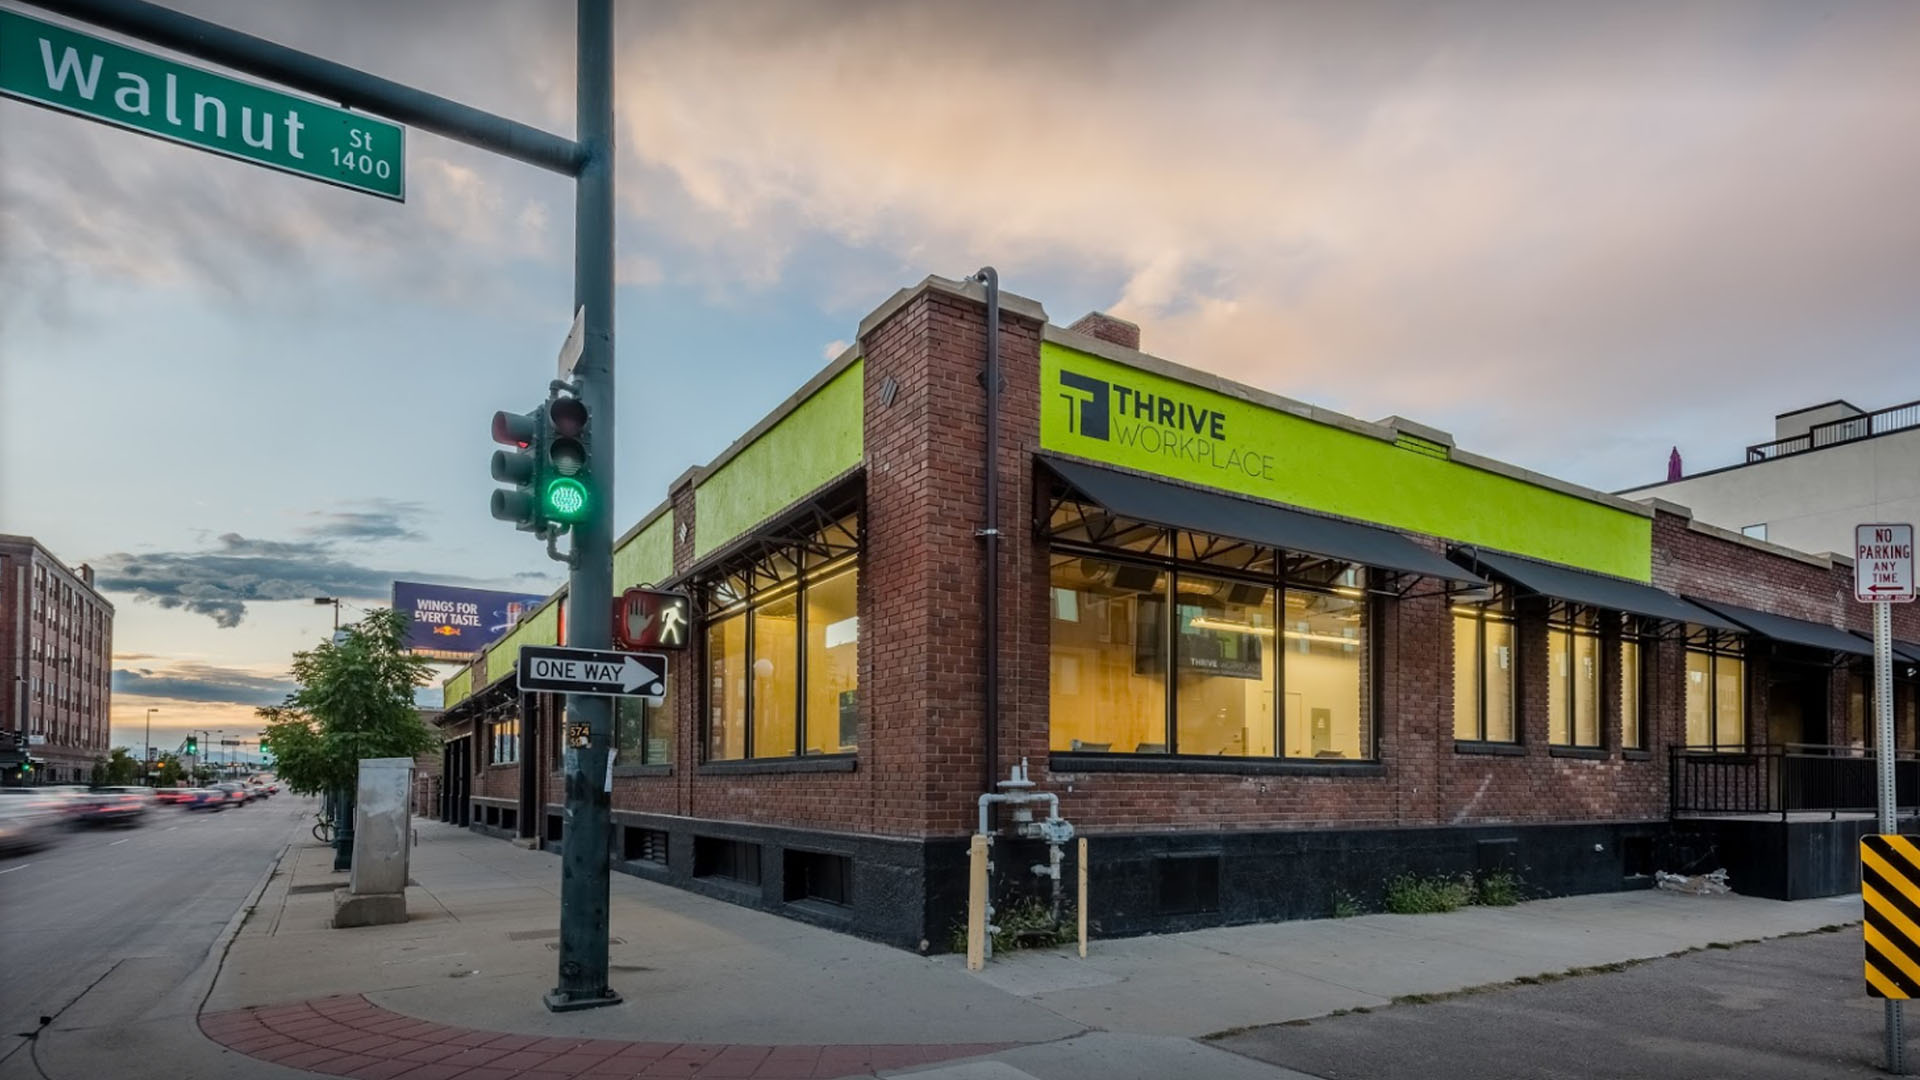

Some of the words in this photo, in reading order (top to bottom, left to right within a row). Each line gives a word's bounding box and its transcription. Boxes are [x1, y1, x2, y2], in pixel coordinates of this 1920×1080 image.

[38, 38, 304, 159] Walnut
[349, 128, 372, 151] St
[331, 147, 390, 180] 1400
[1113, 385, 1226, 441] THRIVE
[1114, 417, 1275, 481] WORKPLACE
[1875, 528, 1892, 543] NO
[1860, 544, 1910, 559] PARKING
[1873, 561, 1896, 571] ANY
[1872, 572, 1898, 583] TIME
[417, 599, 454, 612] WINGS
[457, 602, 477, 615] FOR
[415, 611, 448, 623] EVERY
[1190, 657, 1218, 668] THRIVE
[536, 660, 576, 680] ONE
[584, 663, 624, 682] WAY
[570, 727, 590, 737] 574
